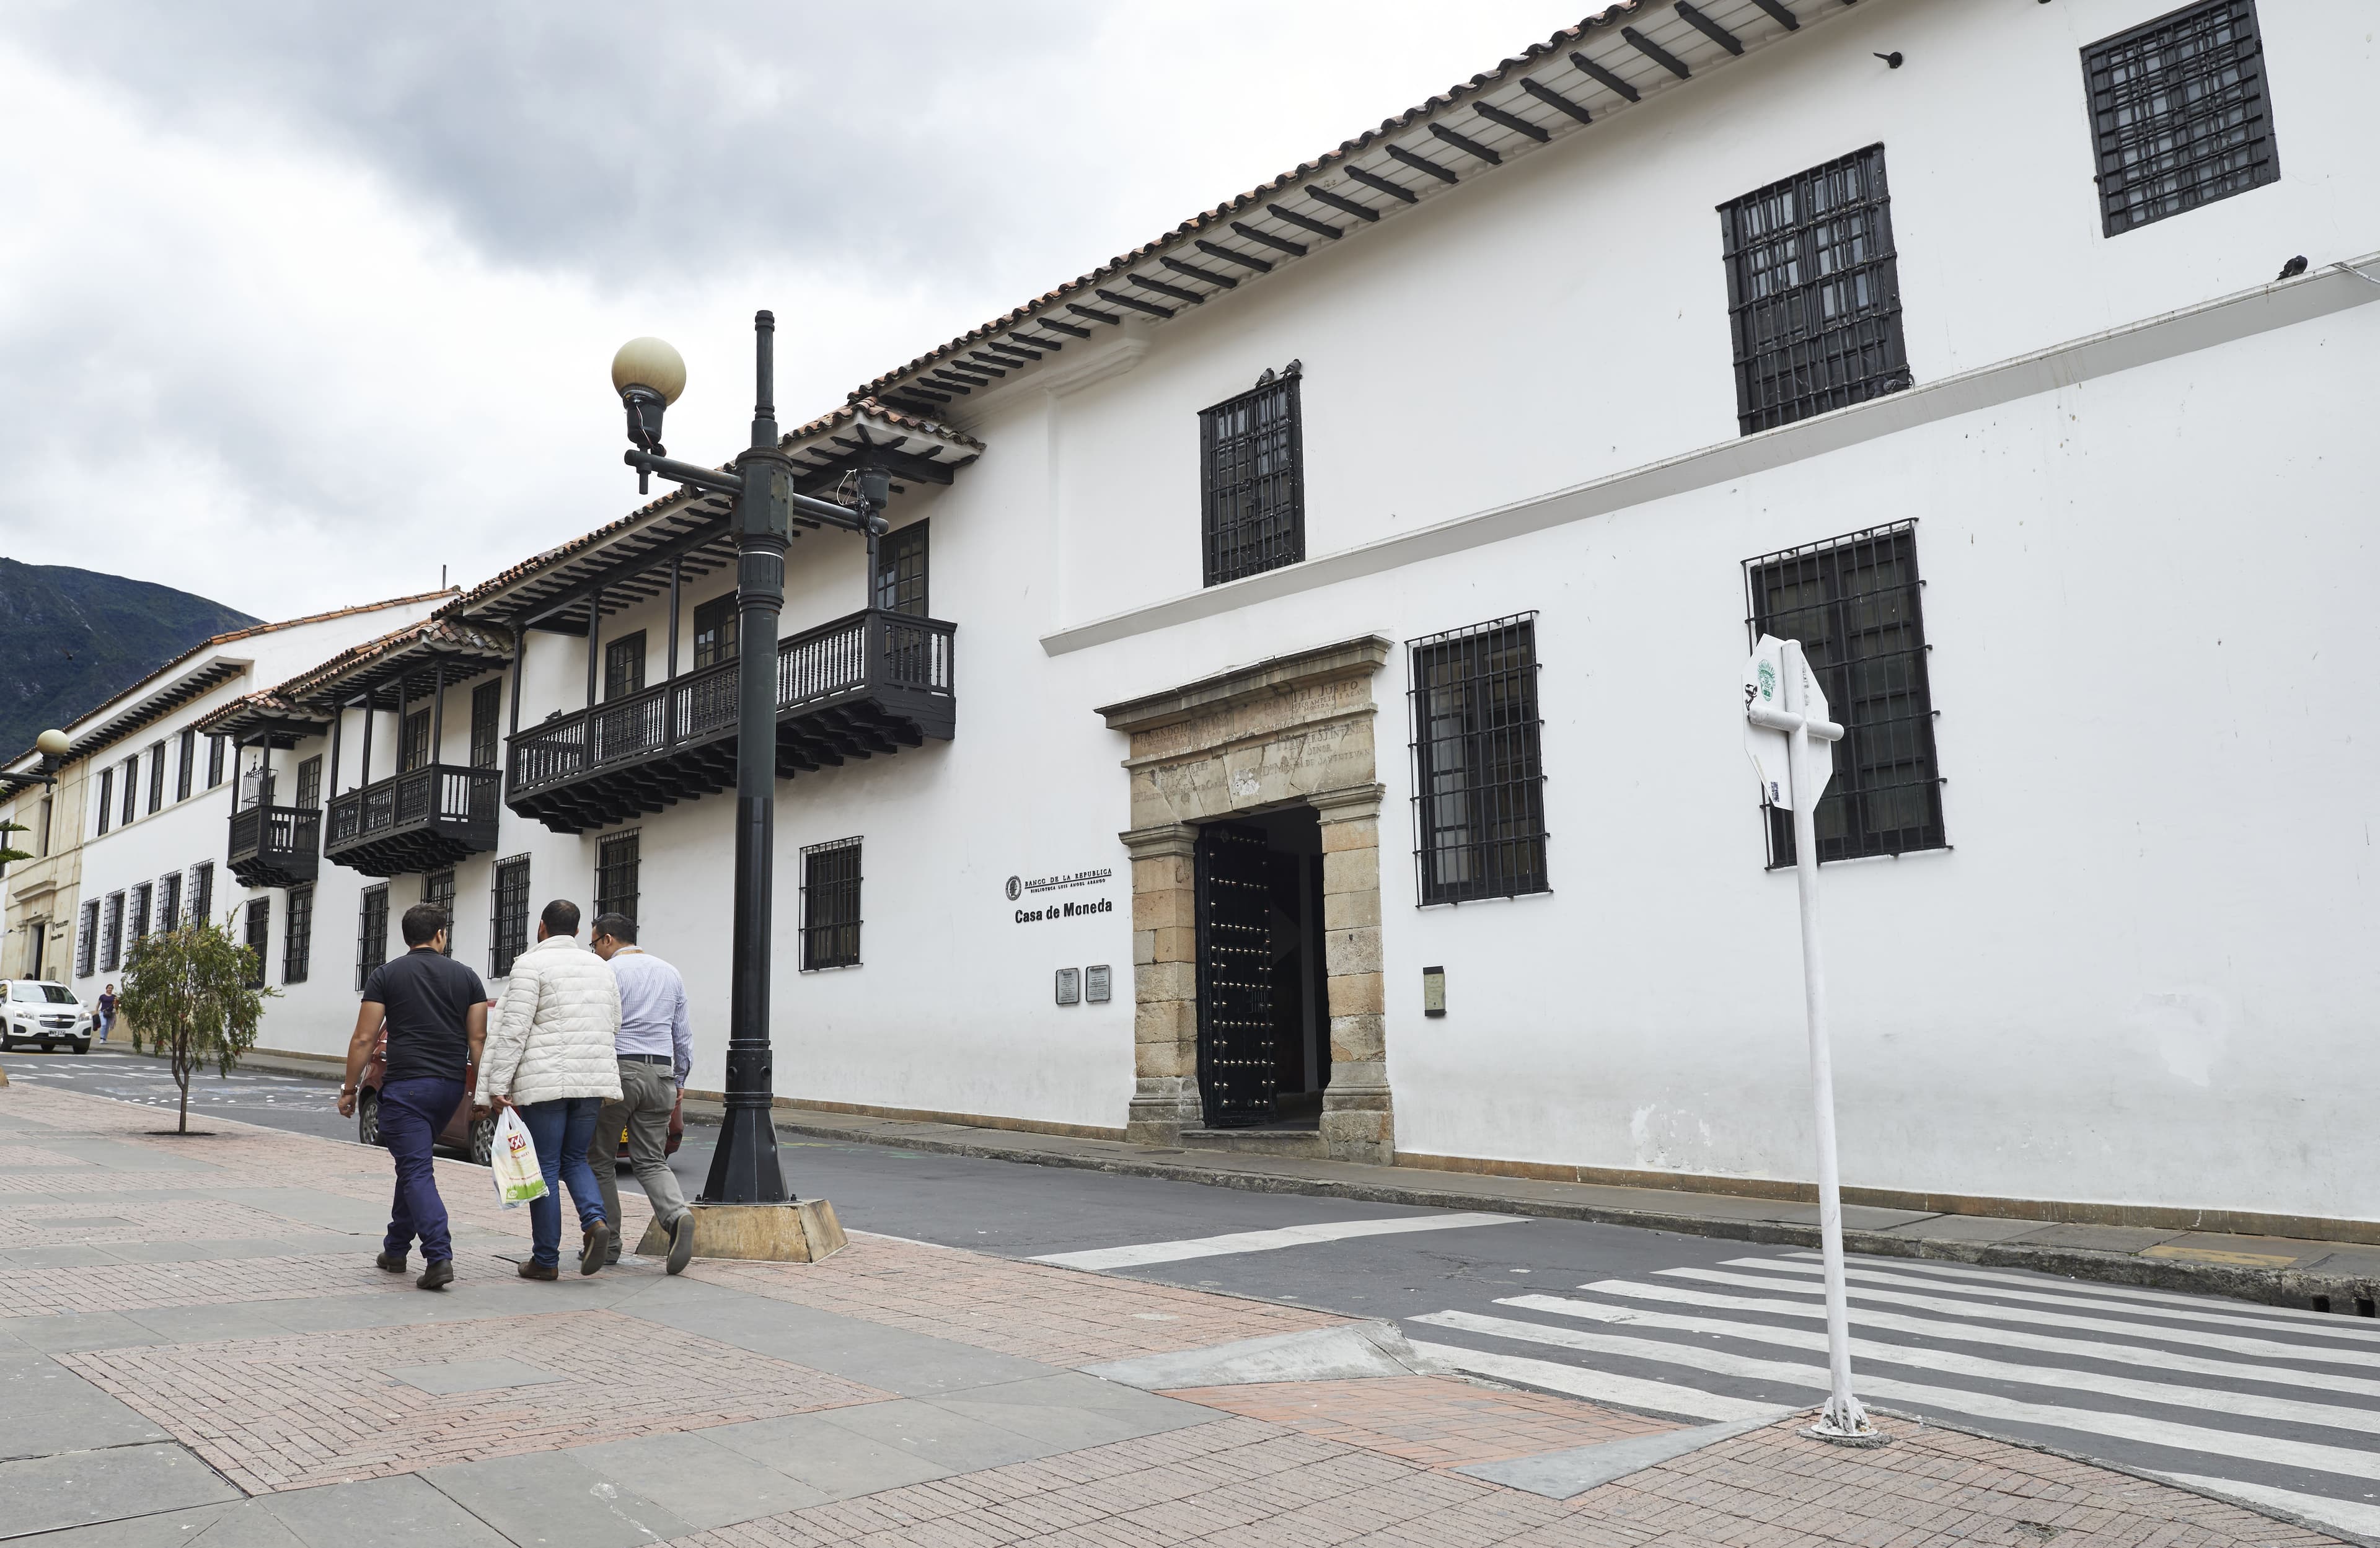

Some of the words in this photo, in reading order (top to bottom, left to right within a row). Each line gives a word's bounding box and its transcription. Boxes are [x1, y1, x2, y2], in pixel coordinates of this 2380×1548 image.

[1025, 878, 1046, 888] BANCO
[1075, 868, 1112, 879] REPUBLICA
[1015, 909, 1042, 924] Casa
[1046, 905, 1060, 920] de
[1064, 897, 1113, 918] Moneda
